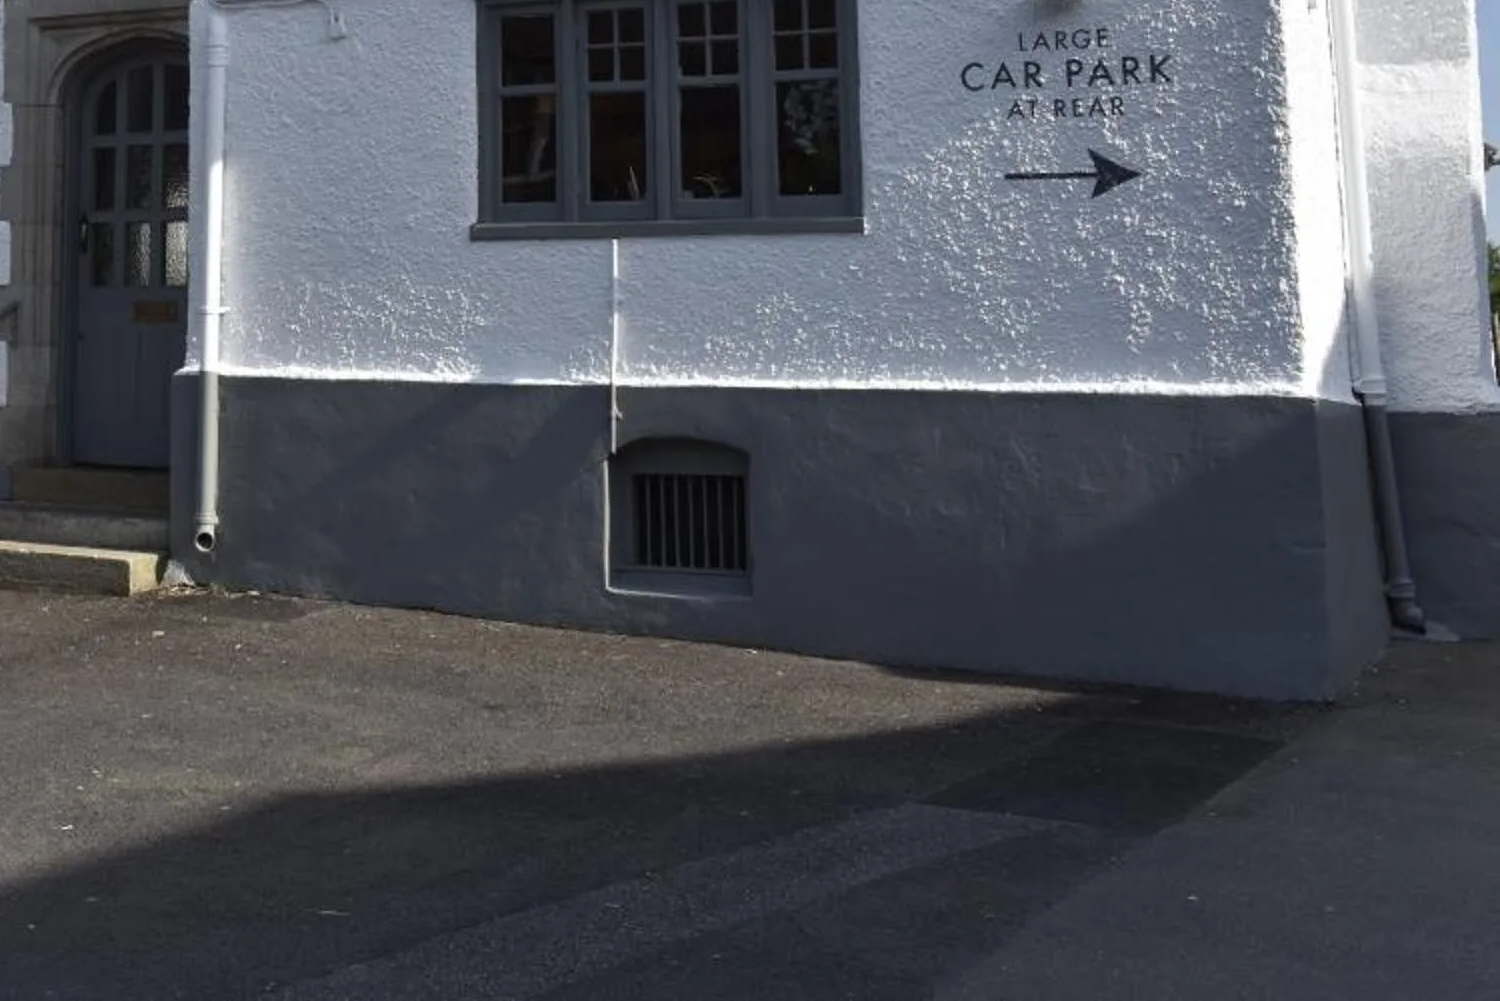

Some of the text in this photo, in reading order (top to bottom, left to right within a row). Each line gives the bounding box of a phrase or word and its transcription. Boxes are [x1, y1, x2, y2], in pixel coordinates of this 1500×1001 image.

[1017, 28, 1111, 51] LARGE
[960, 54, 1172, 92] CAR PARK
[1007, 96, 1125, 120] AT REAR
